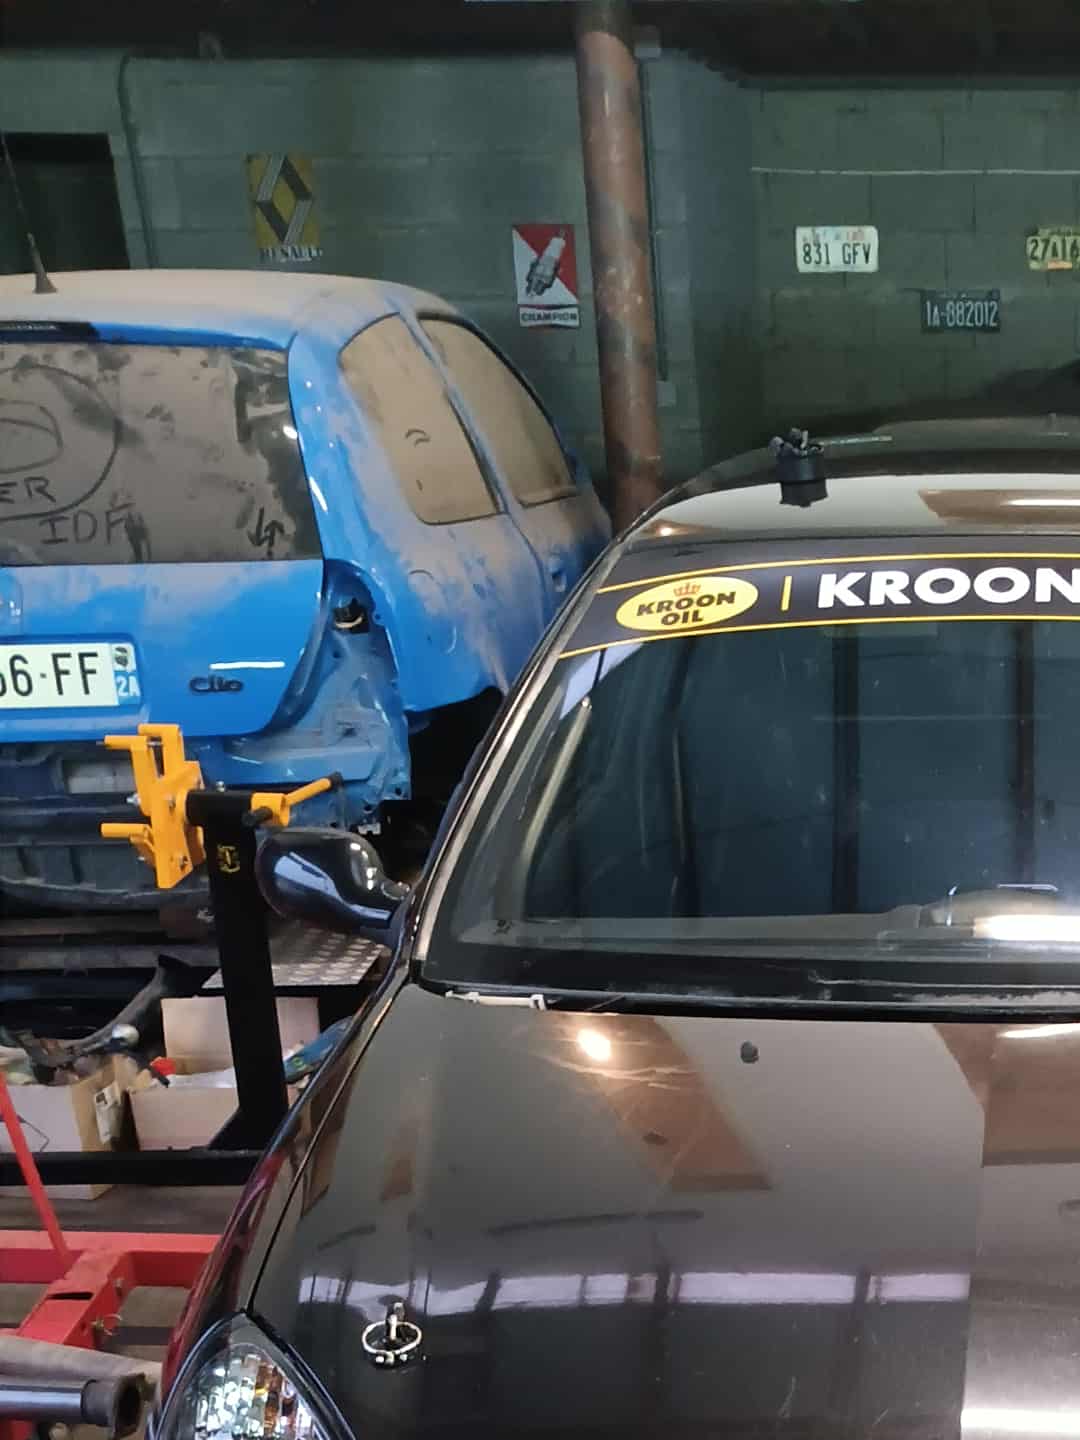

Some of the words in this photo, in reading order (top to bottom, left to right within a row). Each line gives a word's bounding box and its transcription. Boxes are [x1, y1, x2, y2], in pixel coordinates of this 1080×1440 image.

[802, 242, 830, 265] 831
[841, 242, 872, 265] GFV
[521, 311, 577, 322] CHAMPION
[636, 590, 737, 617] KROON
[660, 608, 705, 626] OIL
[116, 675, 141, 697] 2A
[189, 674, 245, 694] Clio
